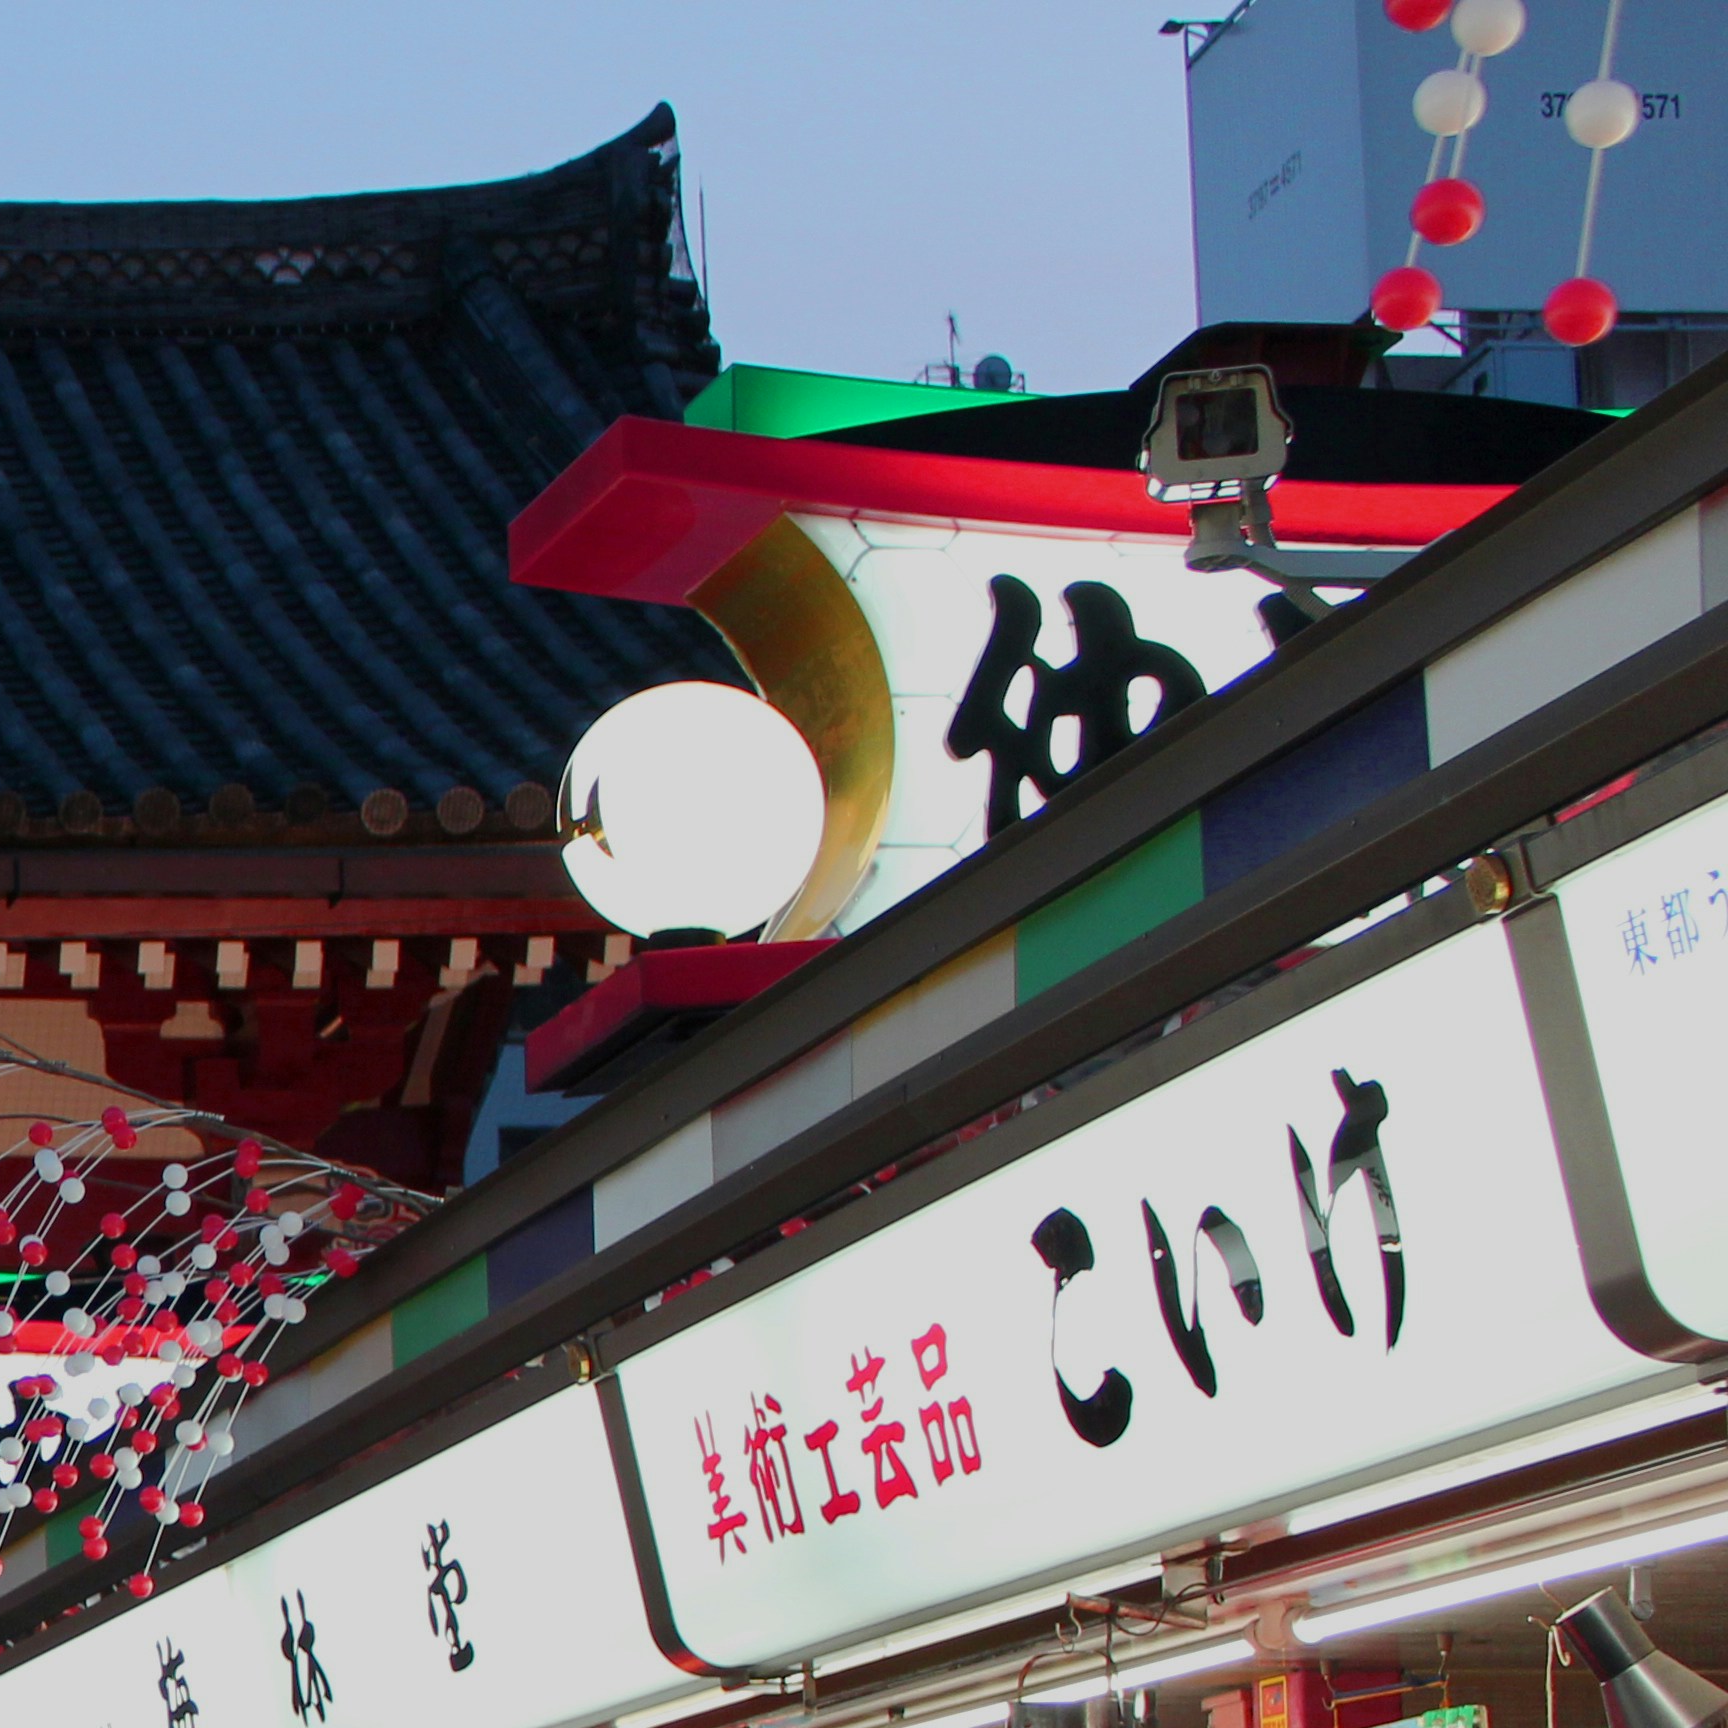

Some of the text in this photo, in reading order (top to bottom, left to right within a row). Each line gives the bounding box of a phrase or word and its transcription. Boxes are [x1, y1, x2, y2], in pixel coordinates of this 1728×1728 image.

[1031, 1068, 1406, 1448] こいけ
[694, 1323, 982, 1565] 美術工芸品
